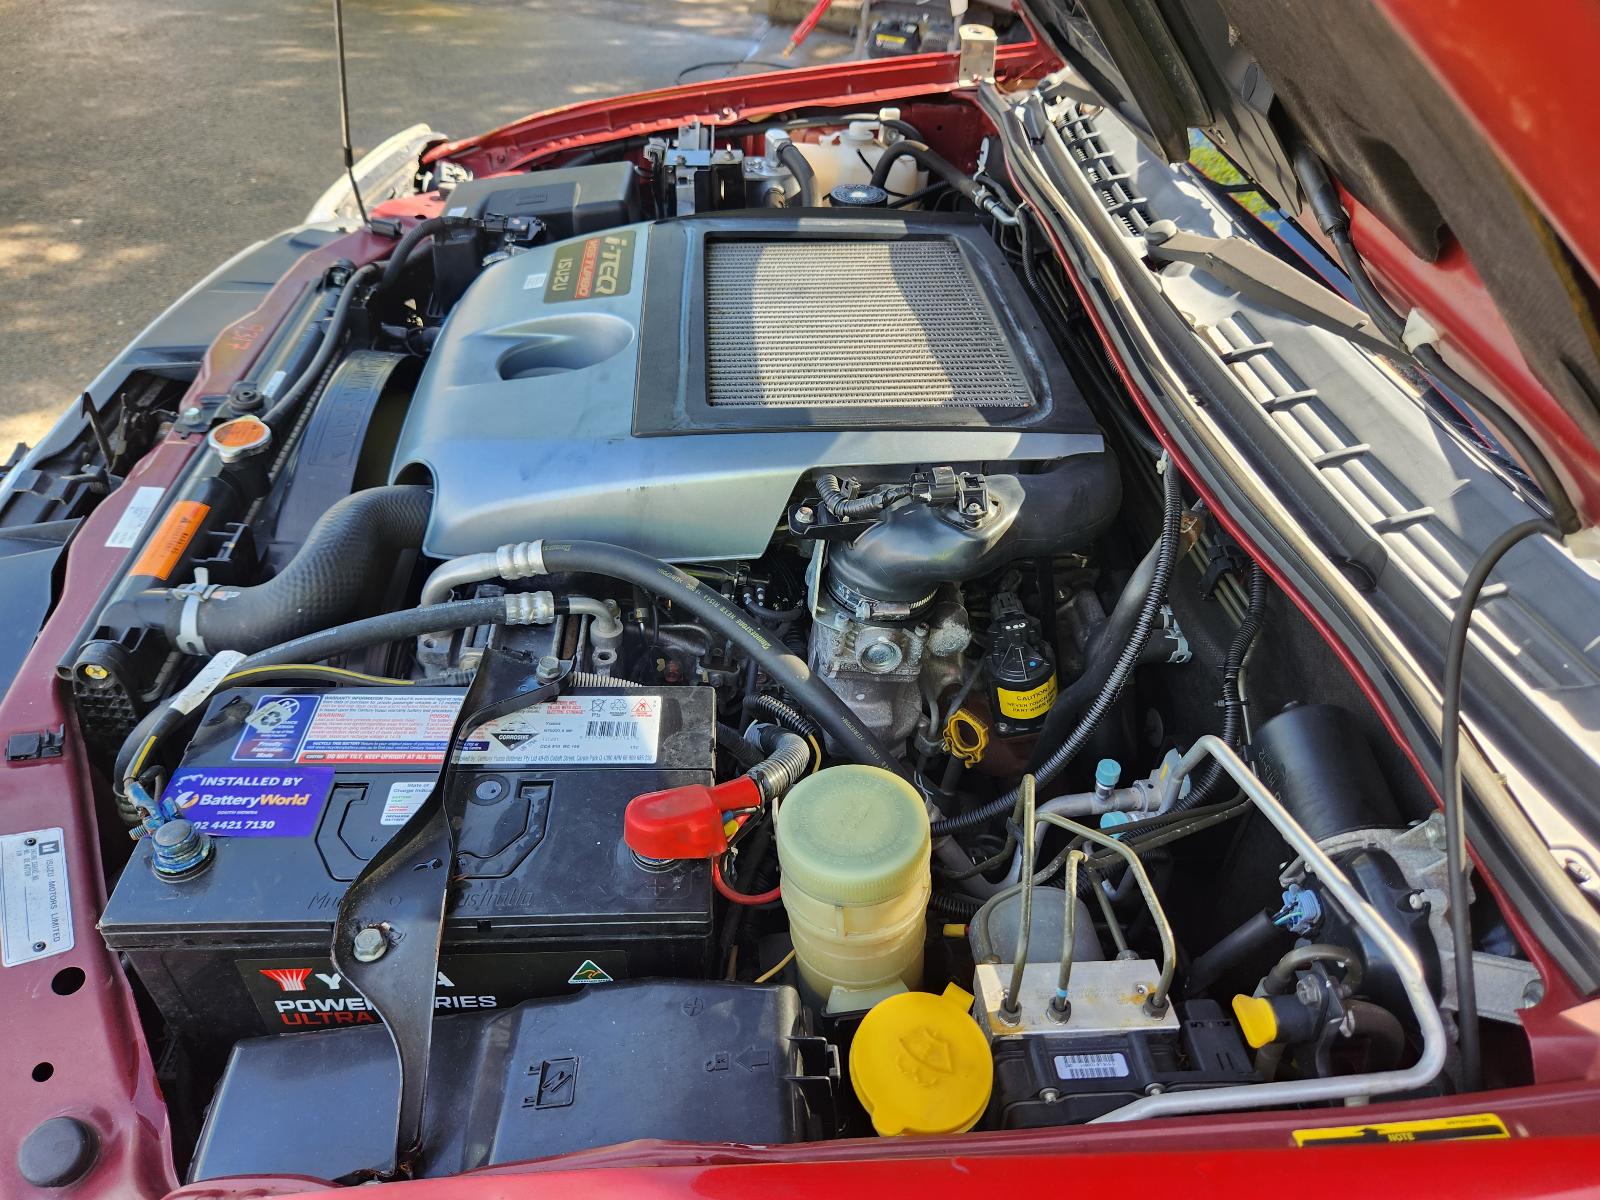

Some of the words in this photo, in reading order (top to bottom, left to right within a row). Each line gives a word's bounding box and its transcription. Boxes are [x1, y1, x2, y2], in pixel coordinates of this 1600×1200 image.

[552, 258, 573, 291] ISUZU
[578, 258, 596, 296] TURBO
[1016, 688, 1048, 701] CAUTION
[200, 776, 280, 786] INSTALLED
[282, 777, 303, 786] BY
[199, 793, 310, 808] BatteryWorld
[210, 820, 242, 830] 4421
[244, 820, 276, 830] 7130
[46, 858, 54, 878] ISUZU
[48, 881, 58, 910] MOTORS
[50, 912, 60, 942] LIMITED
[434, 996, 498, 1008] RIES
[281, 1011, 376, 1026] ULTRA
[1388, 1132, 1416, 1143] NOTE
